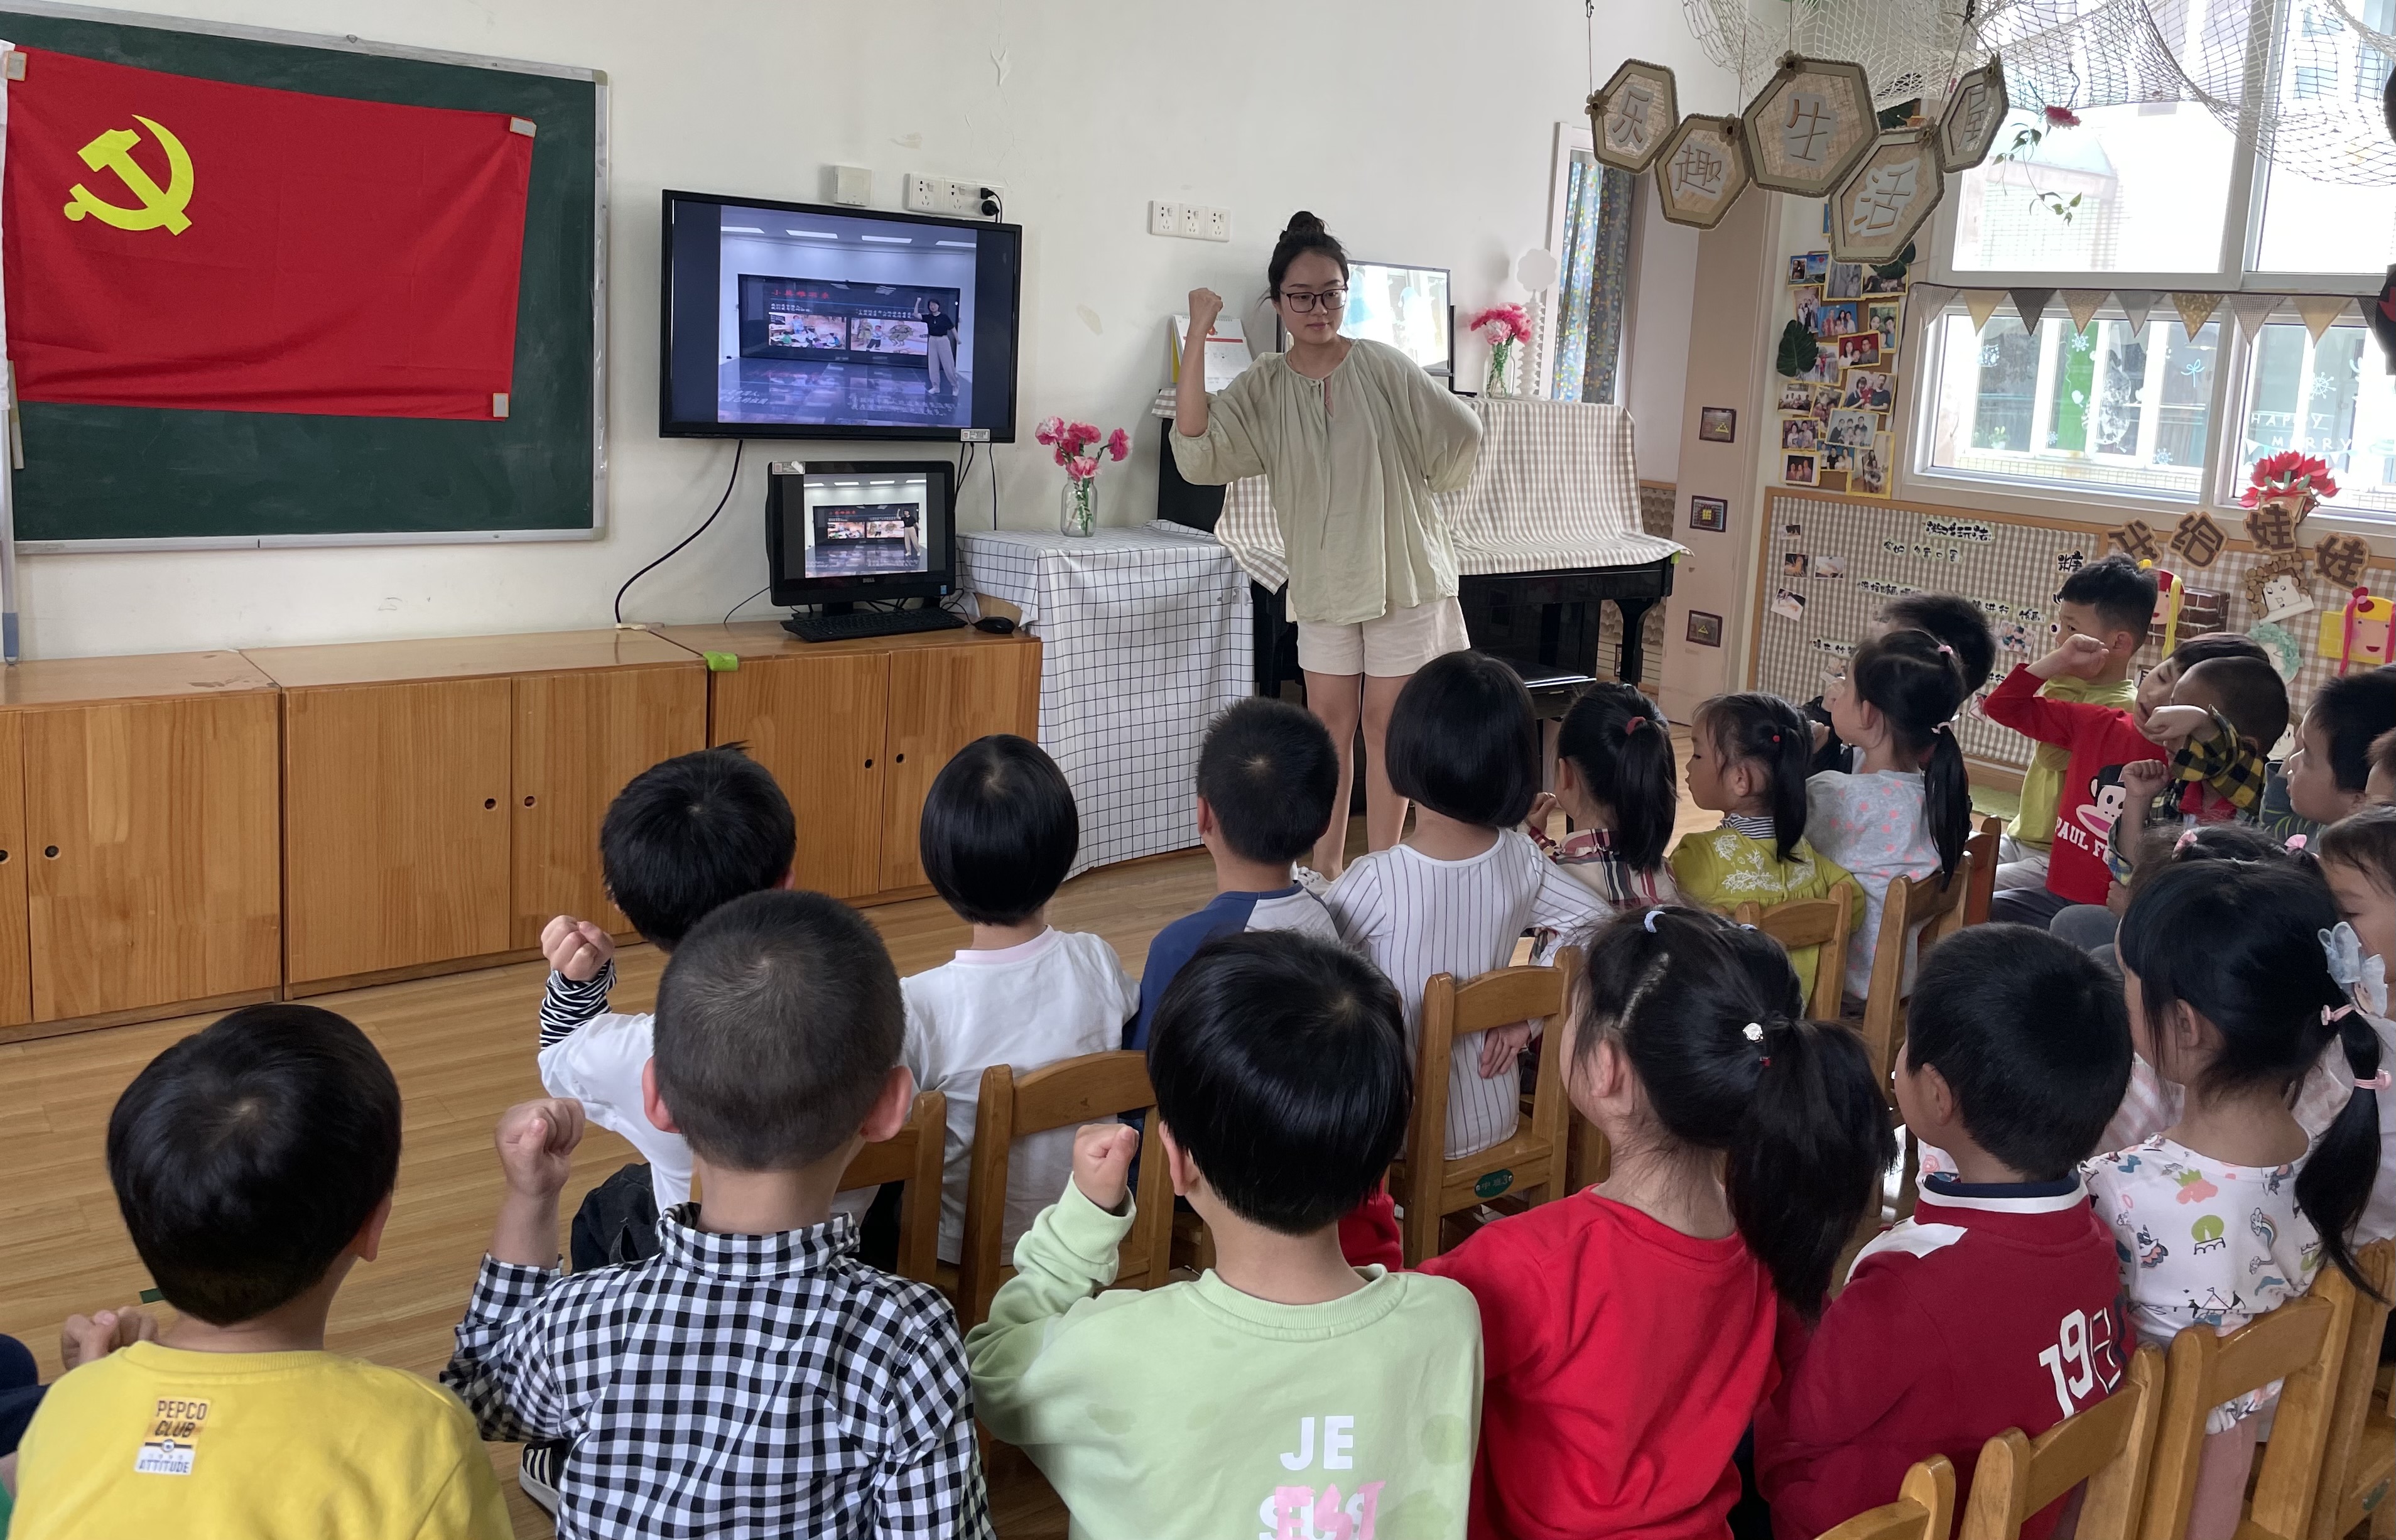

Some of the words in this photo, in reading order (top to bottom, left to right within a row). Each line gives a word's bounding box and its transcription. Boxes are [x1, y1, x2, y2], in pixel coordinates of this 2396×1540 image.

[2055, 816, 2089, 851] PAUL
[156, 1400, 208, 1420] PEPCO
[154, 1420, 195, 1438] CLUB
[1280, 1415, 1354, 1471] JE
[139, 1459, 190, 1473] ATTITUDE
